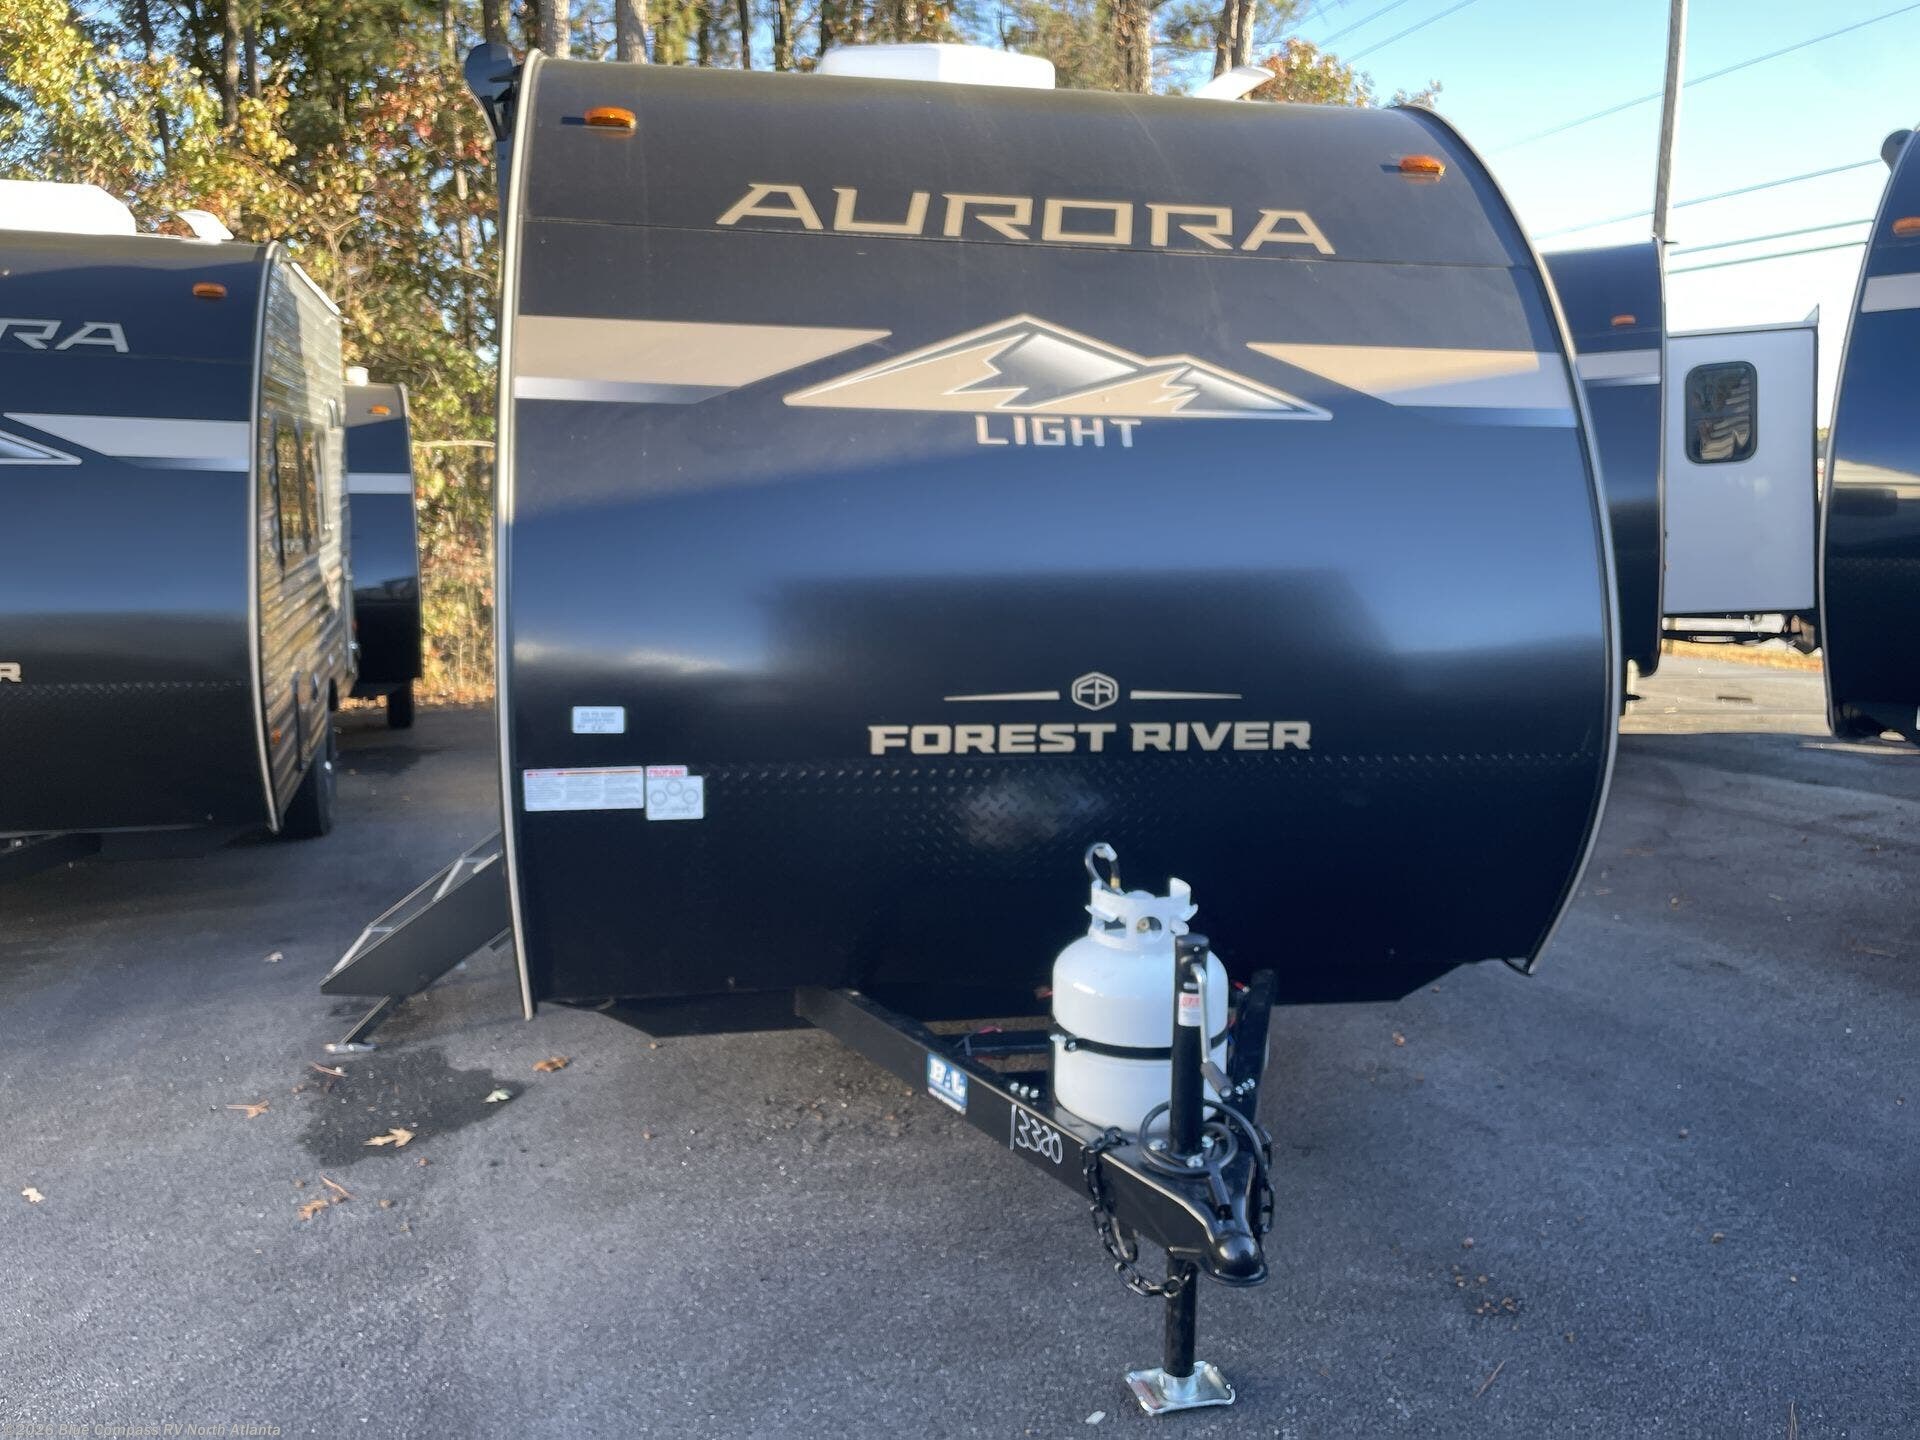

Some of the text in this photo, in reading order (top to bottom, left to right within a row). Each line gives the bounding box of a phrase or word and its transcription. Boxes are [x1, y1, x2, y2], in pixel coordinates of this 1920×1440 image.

[716, 183, 1336, 255] AURORA
[974, 413, 1143, 449] LIGHT
[868, 721, 1312, 755] FOREST RIVER
